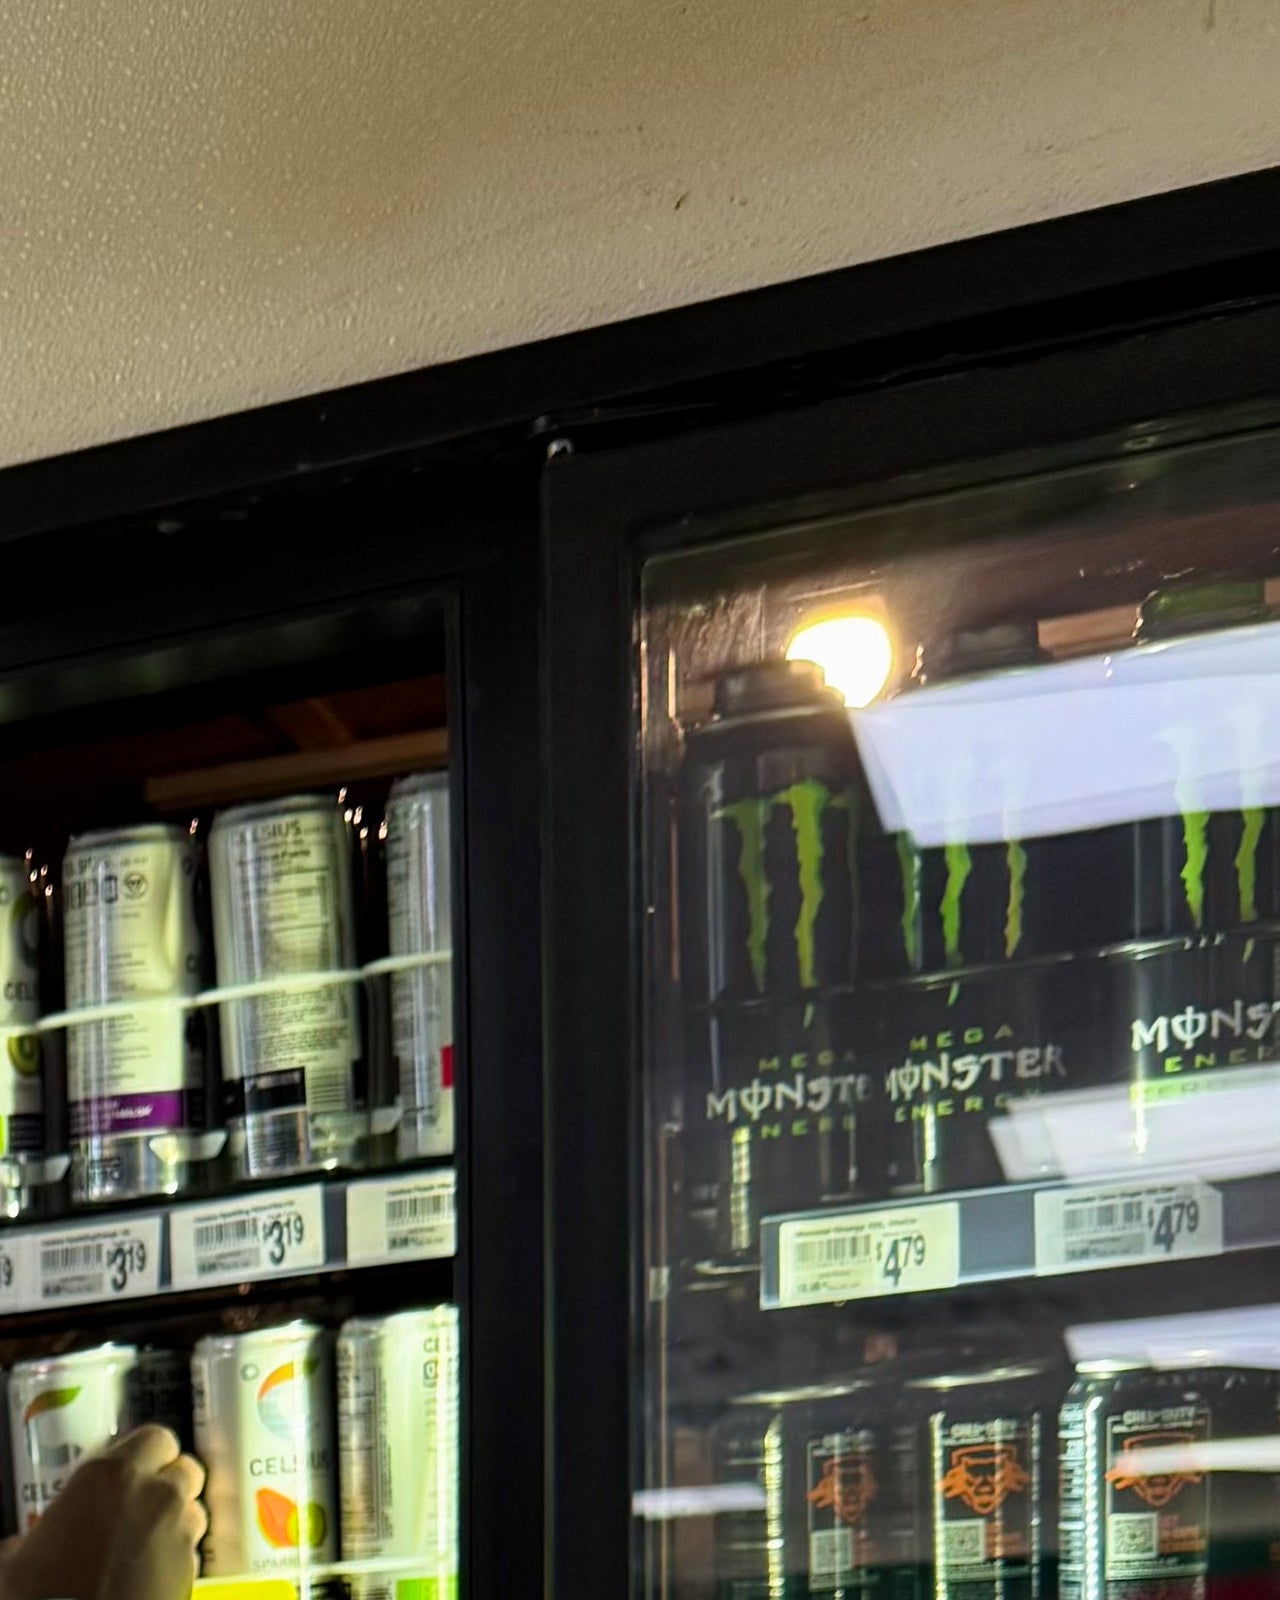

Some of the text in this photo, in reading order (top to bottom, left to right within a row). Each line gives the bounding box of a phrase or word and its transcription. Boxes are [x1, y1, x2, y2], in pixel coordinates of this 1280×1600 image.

[909, 1024, 1014, 1051] MEGA
[884, 1043, 1068, 1102] MONSTER
[706, 1073, 870, 1122] MONSTE
